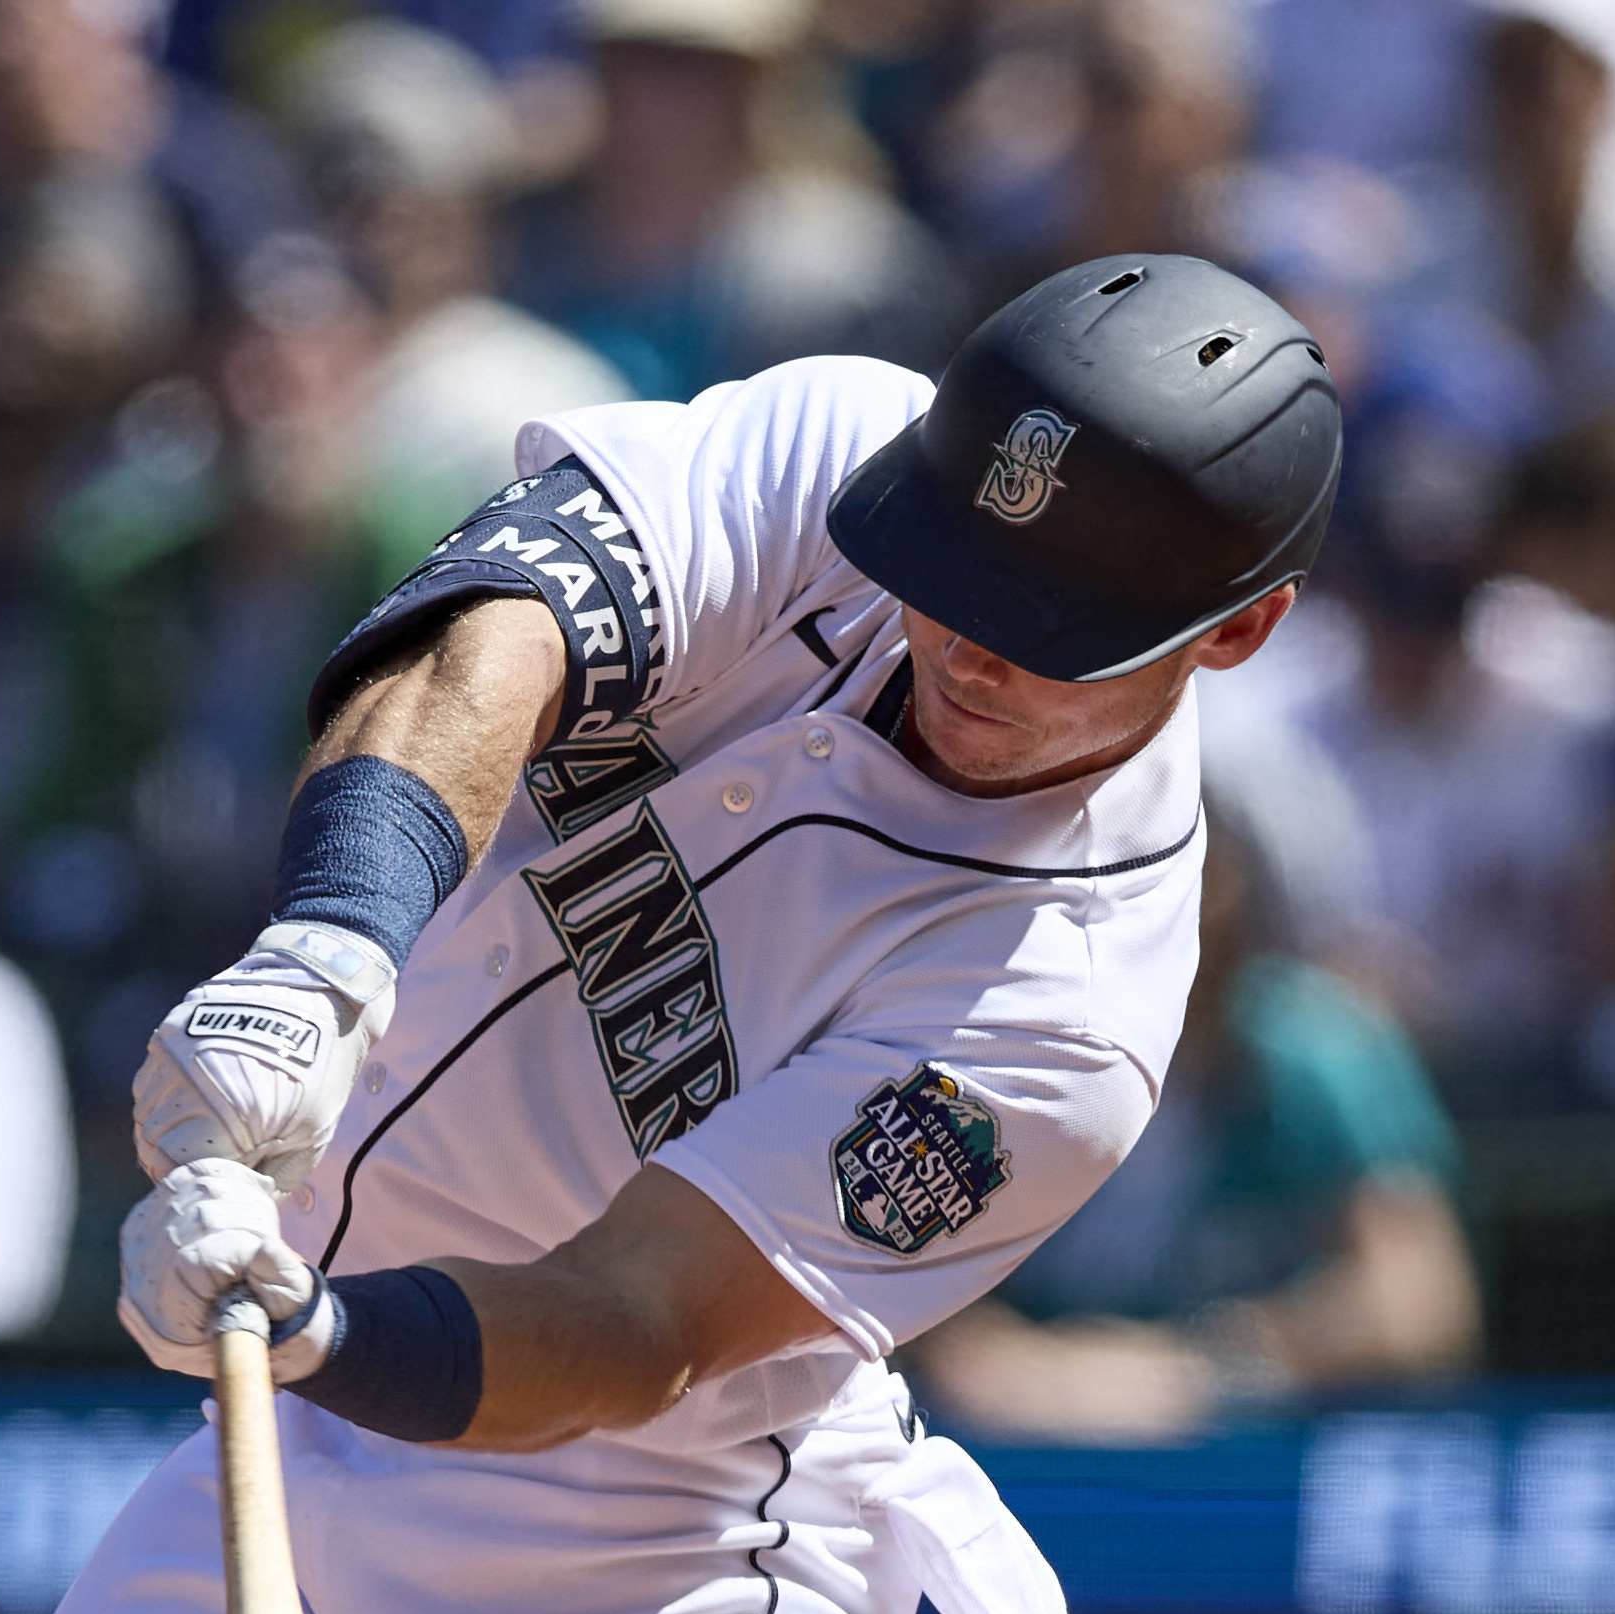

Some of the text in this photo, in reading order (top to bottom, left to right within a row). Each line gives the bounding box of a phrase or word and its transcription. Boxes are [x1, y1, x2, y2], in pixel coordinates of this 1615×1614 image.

[865, 1136, 936, 1227] GAME
[868, 1096, 975, 1229] ALL STAR
[920, 1113, 973, 1176] SEATTLE
